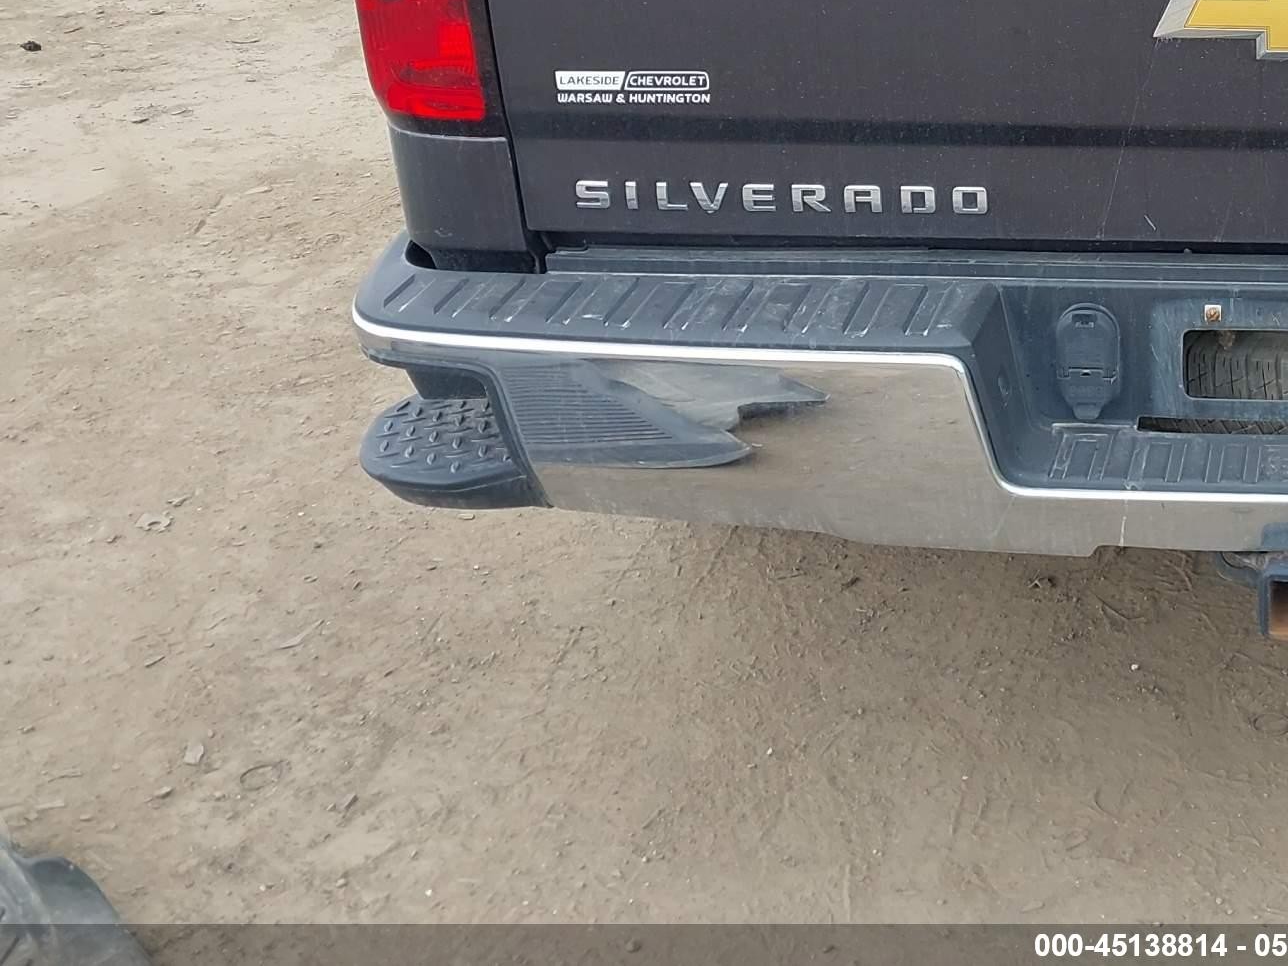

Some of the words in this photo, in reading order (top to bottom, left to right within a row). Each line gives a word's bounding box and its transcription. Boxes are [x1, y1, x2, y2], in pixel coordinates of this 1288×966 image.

[559, 75, 620, 85] LAKESIDE
[629, 75, 707, 86] CHEVROLET
[557, 93, 613, 104] WARSAW
[615, 93, 626, 104] &
[628, 93, 711, 104] HUNTINGTON
[575, 179, 988, 214] SILVERADO
